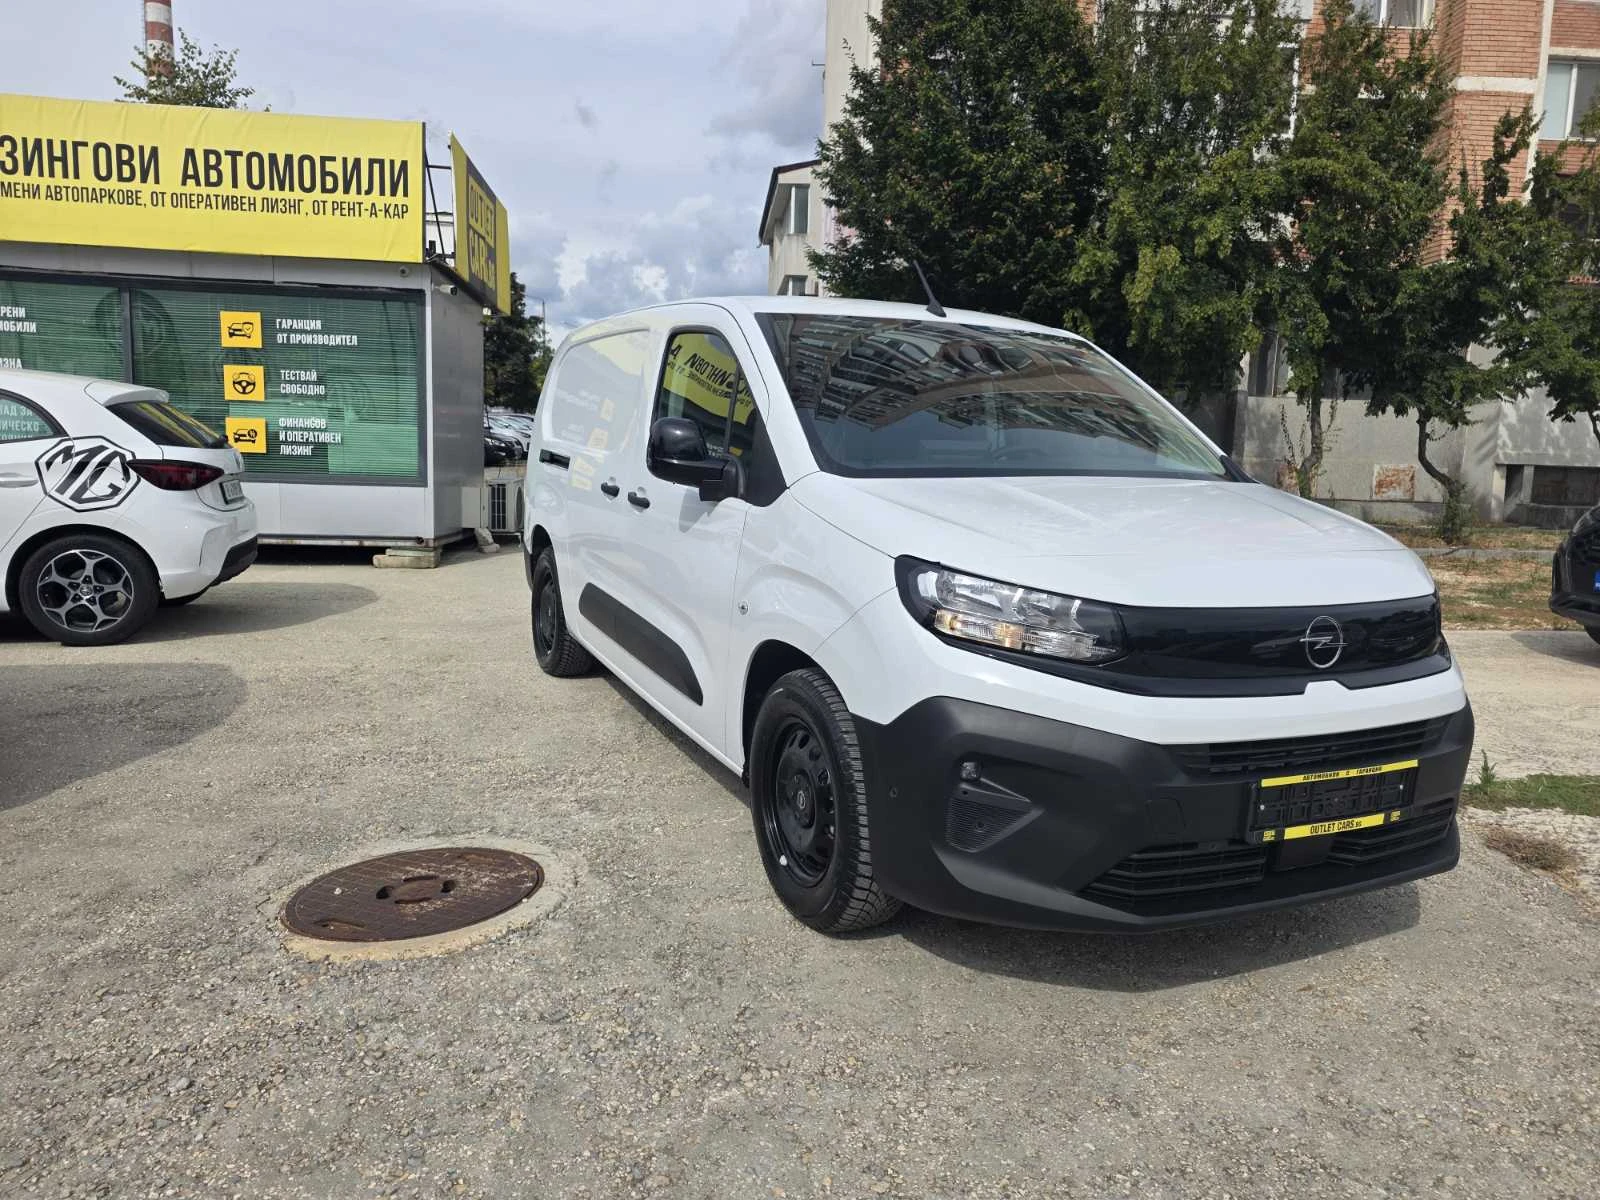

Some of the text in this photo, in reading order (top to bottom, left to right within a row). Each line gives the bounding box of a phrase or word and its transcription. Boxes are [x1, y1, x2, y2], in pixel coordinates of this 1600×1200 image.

[0, 134, 409, 198] ЗИНГОВИ АВТОМОБИЛИ
[0, 181, 41, 200] МЕНИ
[45, 184, 147, 209] АВТОПАРКОВЕ,
[151, 191, 167, 207] ОТ
[170, 192, 257, 213] ОПЕРАТИВЕН
[312, 199, 328, 216] ОТ
[331, 200, 409, 220] РЕНТ-А-КАР
[0, 306, 26, 318] РЕНИ
[276, 318, 322, 331] ГАРАНЦИЯ
[277, 333, 358, 346] ОТ ПРОИЗВОДИТЕЛ
[280, 369, 318, 382] ТЕСТВАЙ
[280, 383, 325, 395] СВОБОДНО
[279, 416, 326, 429] ФИНАНСОВ
[279, 430, 342, 443] И ОПЕРАТИВЕН
[280, 444, 314, 456] ЛИЗИНГ
[45, 445, 131, 504] MG
[1310, 822, 1336, 835] OUTLET
